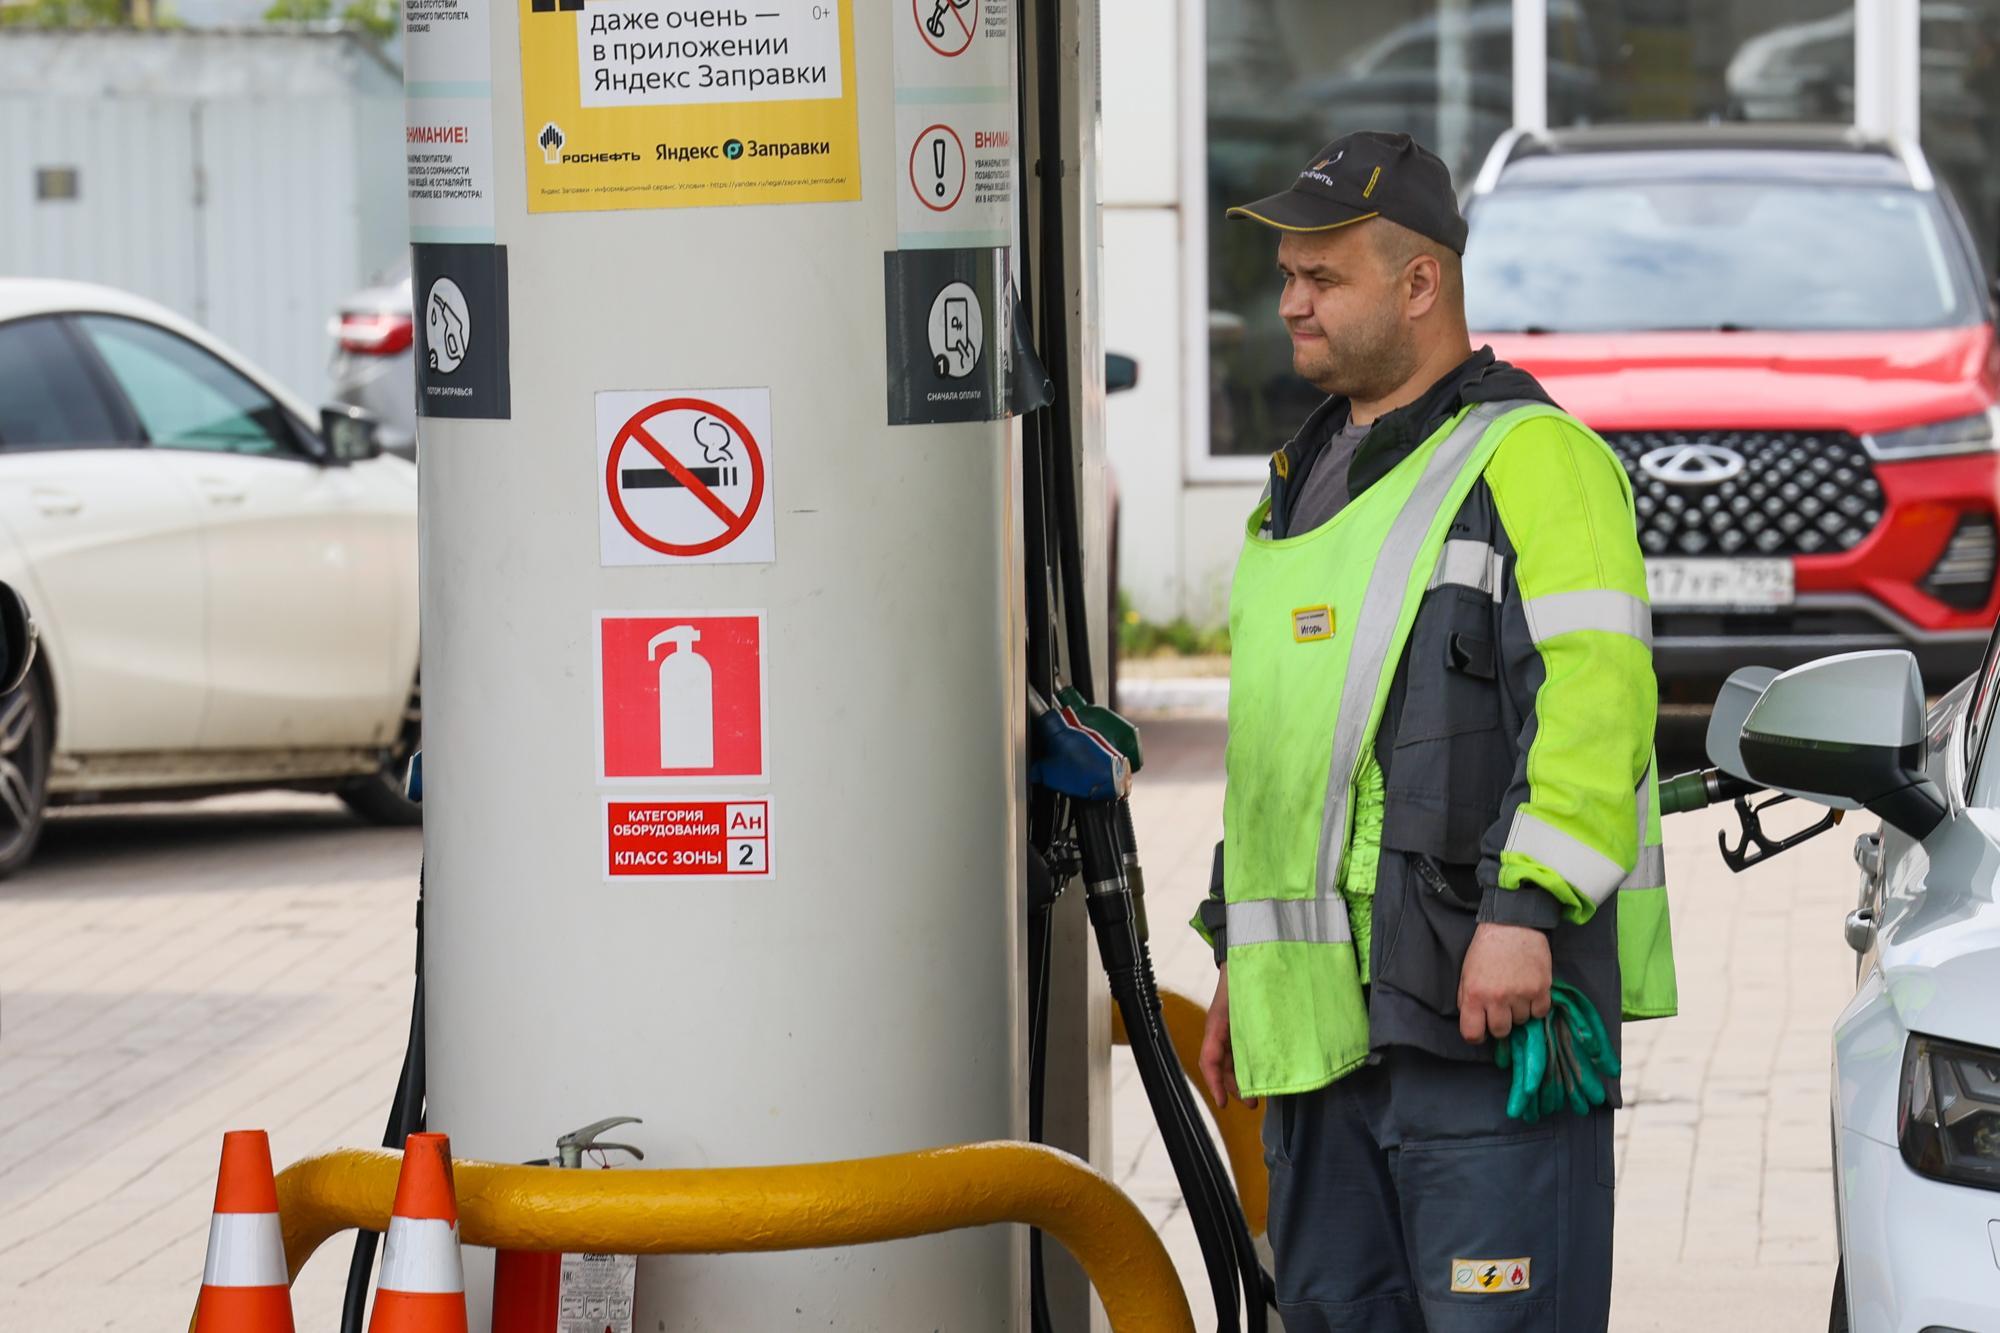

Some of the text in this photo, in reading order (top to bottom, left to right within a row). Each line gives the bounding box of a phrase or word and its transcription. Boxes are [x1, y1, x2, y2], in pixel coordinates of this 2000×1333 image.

[434, 11, 470, 21] ПИСТОЛЕТА
[812, 5, 831, 21] 0+
[591, 11, 659, 35] даже
[666, 9, 747, 29] очень
[593, 37, 788, 65] в приложении
[594, 65, 827, 94] Яндекс Заправки
[562, 152, 641, 163] РОСНЕФТЬ
[655, 140, 830, 162] Яндекс Заправки
[430, 166, 470, 175] СОХРАННОСТИ
[435, 177, 473, 187] ОСТАВЛЯЙТЕ
[443, 190, 483, 199] ПРИСМОТРА!
[430, 354, 437, 368] 2
[938, 360, 945, 374] 1
[441, 386, 473, 396] ЗАПРАВЬСЯ
[926, 390, 981, 402] СНАЧАЛА ОПЛАТИ
[1300, 624, 1322, 635] Игорь
[628, 810, 704, 822] КАТЕГОРИЯ
[613, 824, 720, 837] ОБОРУДОВАНИЯ
[614, 851, 722, 865] КЛАСС ЗОНЫ
[738, 844, 753, 866] 2
